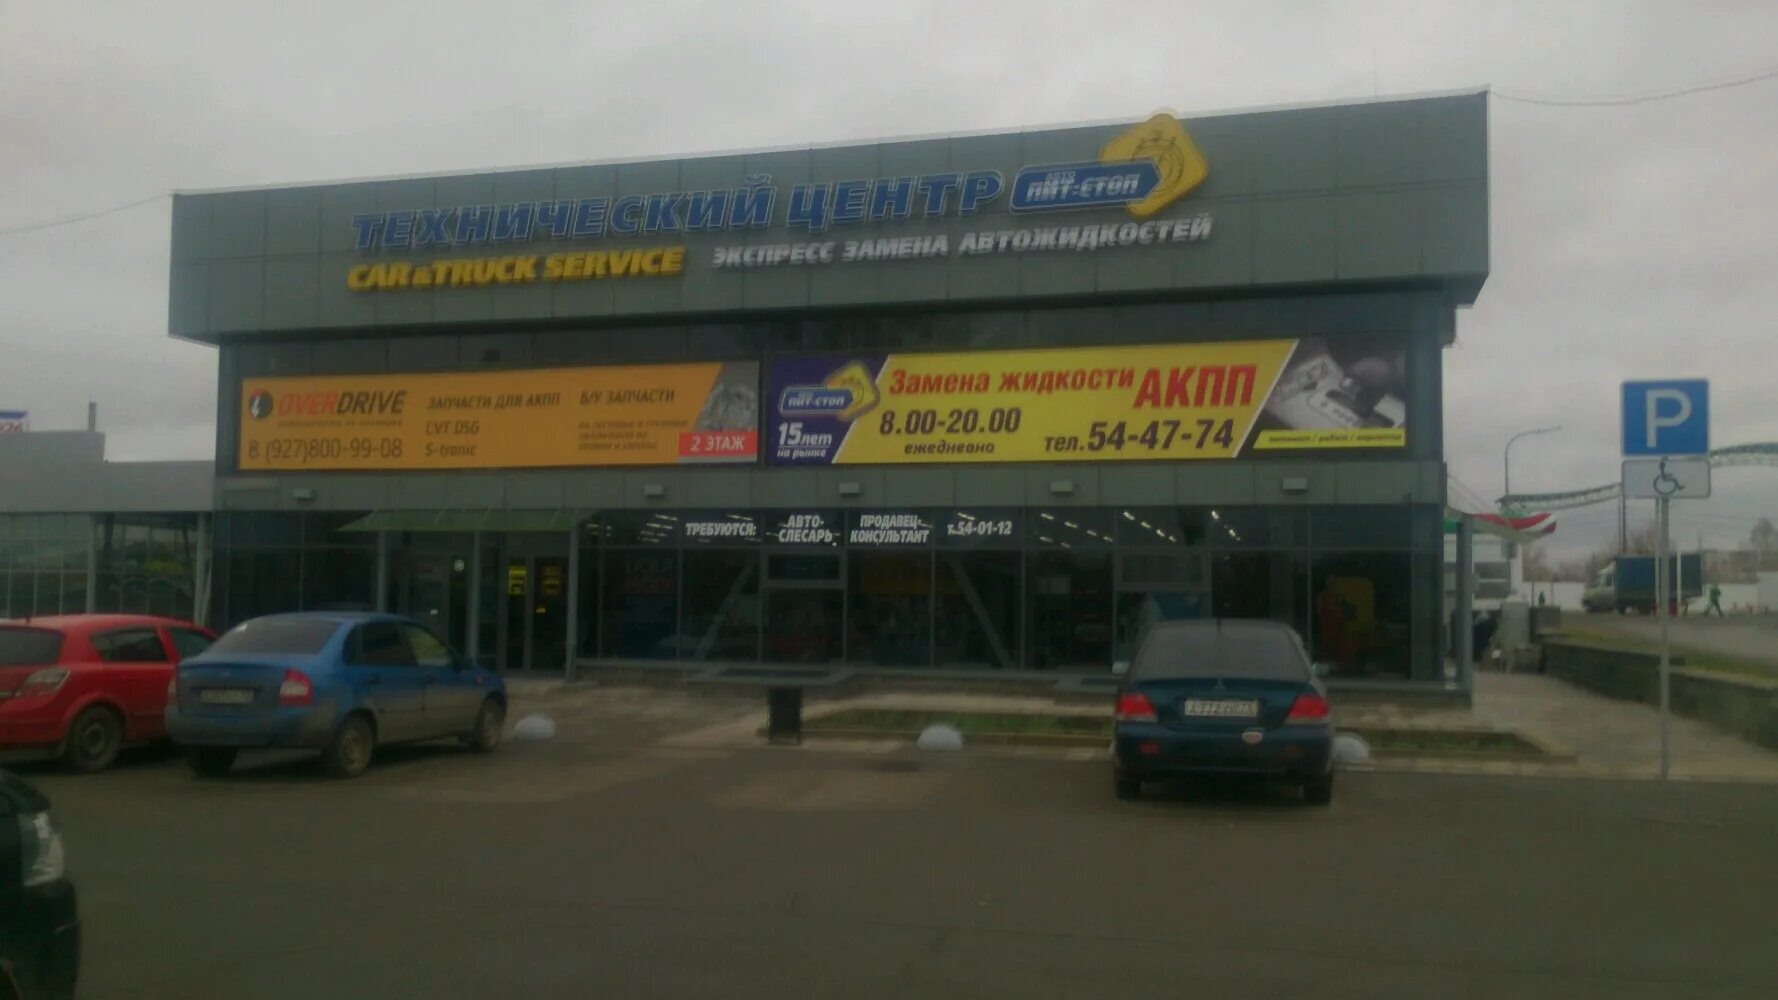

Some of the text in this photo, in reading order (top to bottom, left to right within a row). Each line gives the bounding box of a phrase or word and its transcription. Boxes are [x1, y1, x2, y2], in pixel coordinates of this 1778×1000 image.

[352, 169, 1006, 249] ТЕХНИЧЕСКИЙ ЦЕНТР
[712, 212, 1214, 268] ЭКСПРЕСС ЗАМЕНА АВТОЖИДКОСТЕЙ
[542, 245, 686, 281] SERVICE
[889, 365, 1258, 408] Замена жидкости АКПП
[278, 390, 407, 416] OVERDRIVE
[428, 392, 561, 410] ЗАПЧАСТИ ДЛЯ АКПП
[580, 389, 675, 406] Б/У ЗАПЧАСТИ
[880, 408, 1021, 434] 8.00-20.00
[1646, 388, 1692, 447] P
[426, 420, 479, 435] CVT DSG
[266, 437, 403, 464] (927)800-99-08
[425, 442, 476, 457] S-tronic
[690, 435, 745, 451] 2 ЭТАЖ
[904, 440, 995, 455] ежедневно
[777, 448, 826, 460] на рынке
[786, 514, 825, 528] АВТО-
[860, 514, 922, 528] ПРОДАВЕЦ-
[685, 522, 756, 537] ТРЕБУЮТСЯ:
[778, 528, 833, 544] СЛЕСАРЬ
[850, 529, 929, 544] КОНСУЛЬТАНТ
